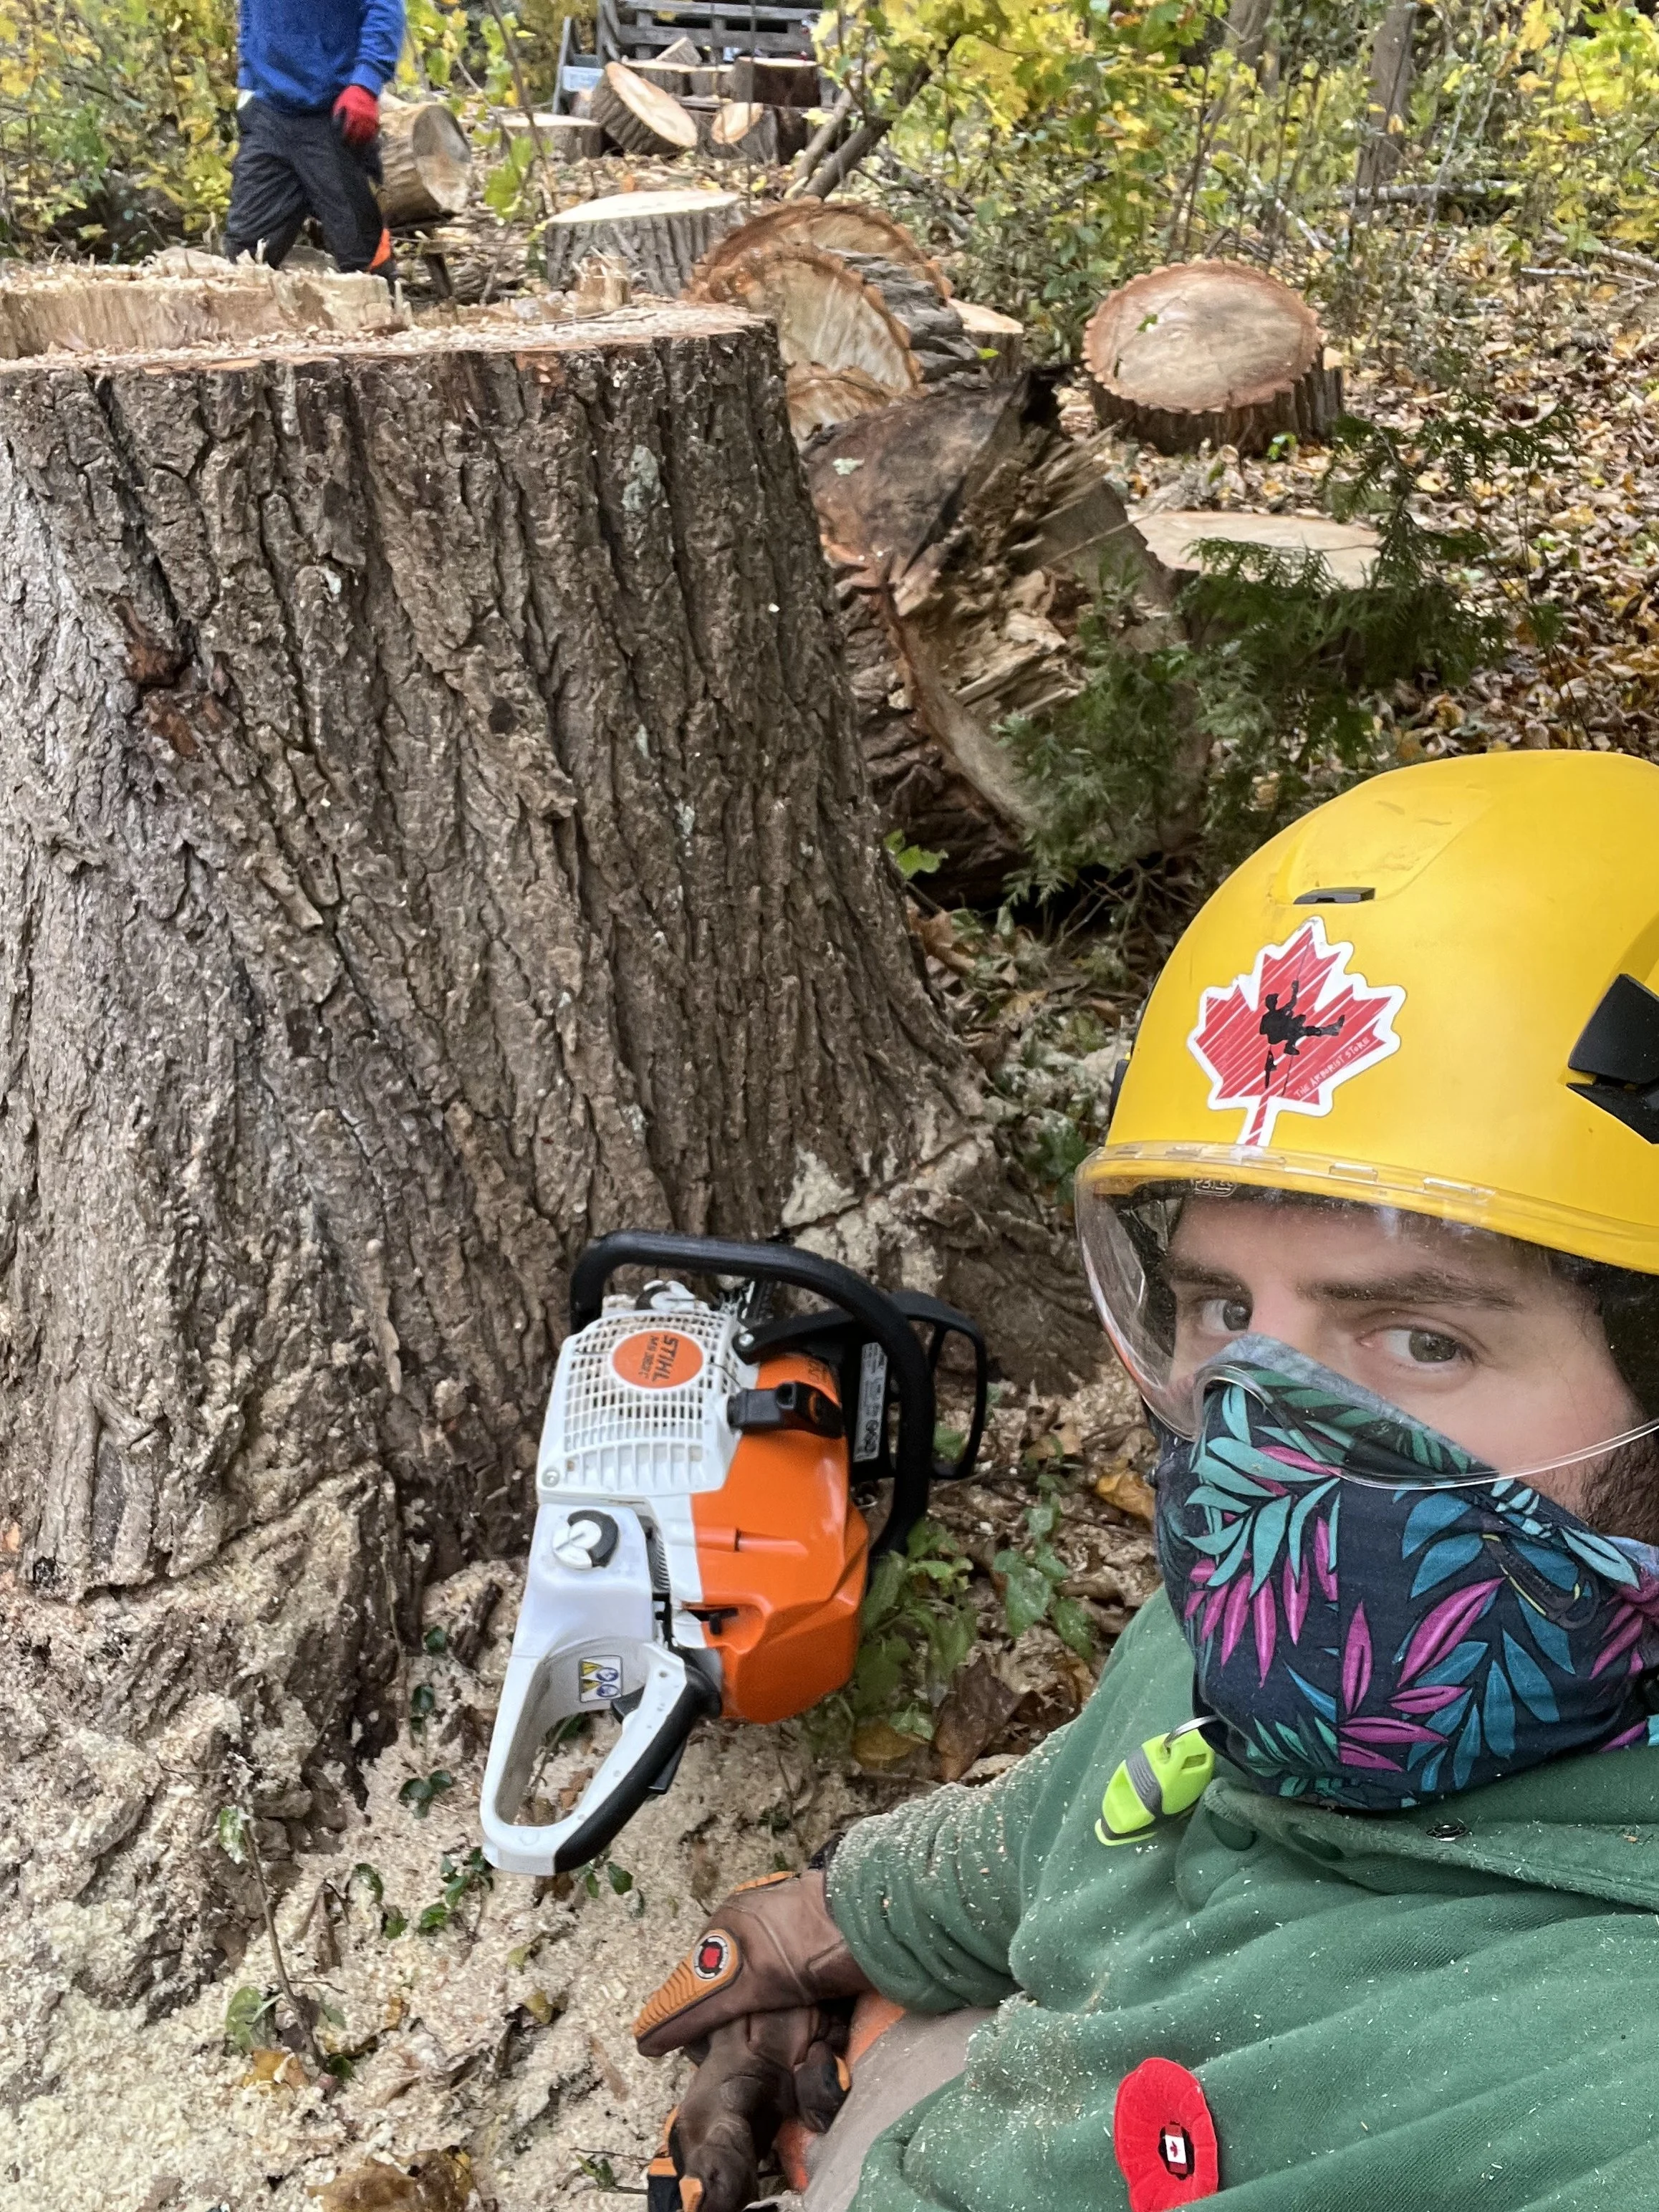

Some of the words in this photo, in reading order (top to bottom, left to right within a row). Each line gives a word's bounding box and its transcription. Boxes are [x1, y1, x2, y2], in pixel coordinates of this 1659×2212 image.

[1294, 1083, 1310, 1097] THE
[1309, 1054, 1345, 1087] ARBORIST
[1345, 1037, 1370, 1058] STORE
[652, 1335, 679, 1382] STIHL
